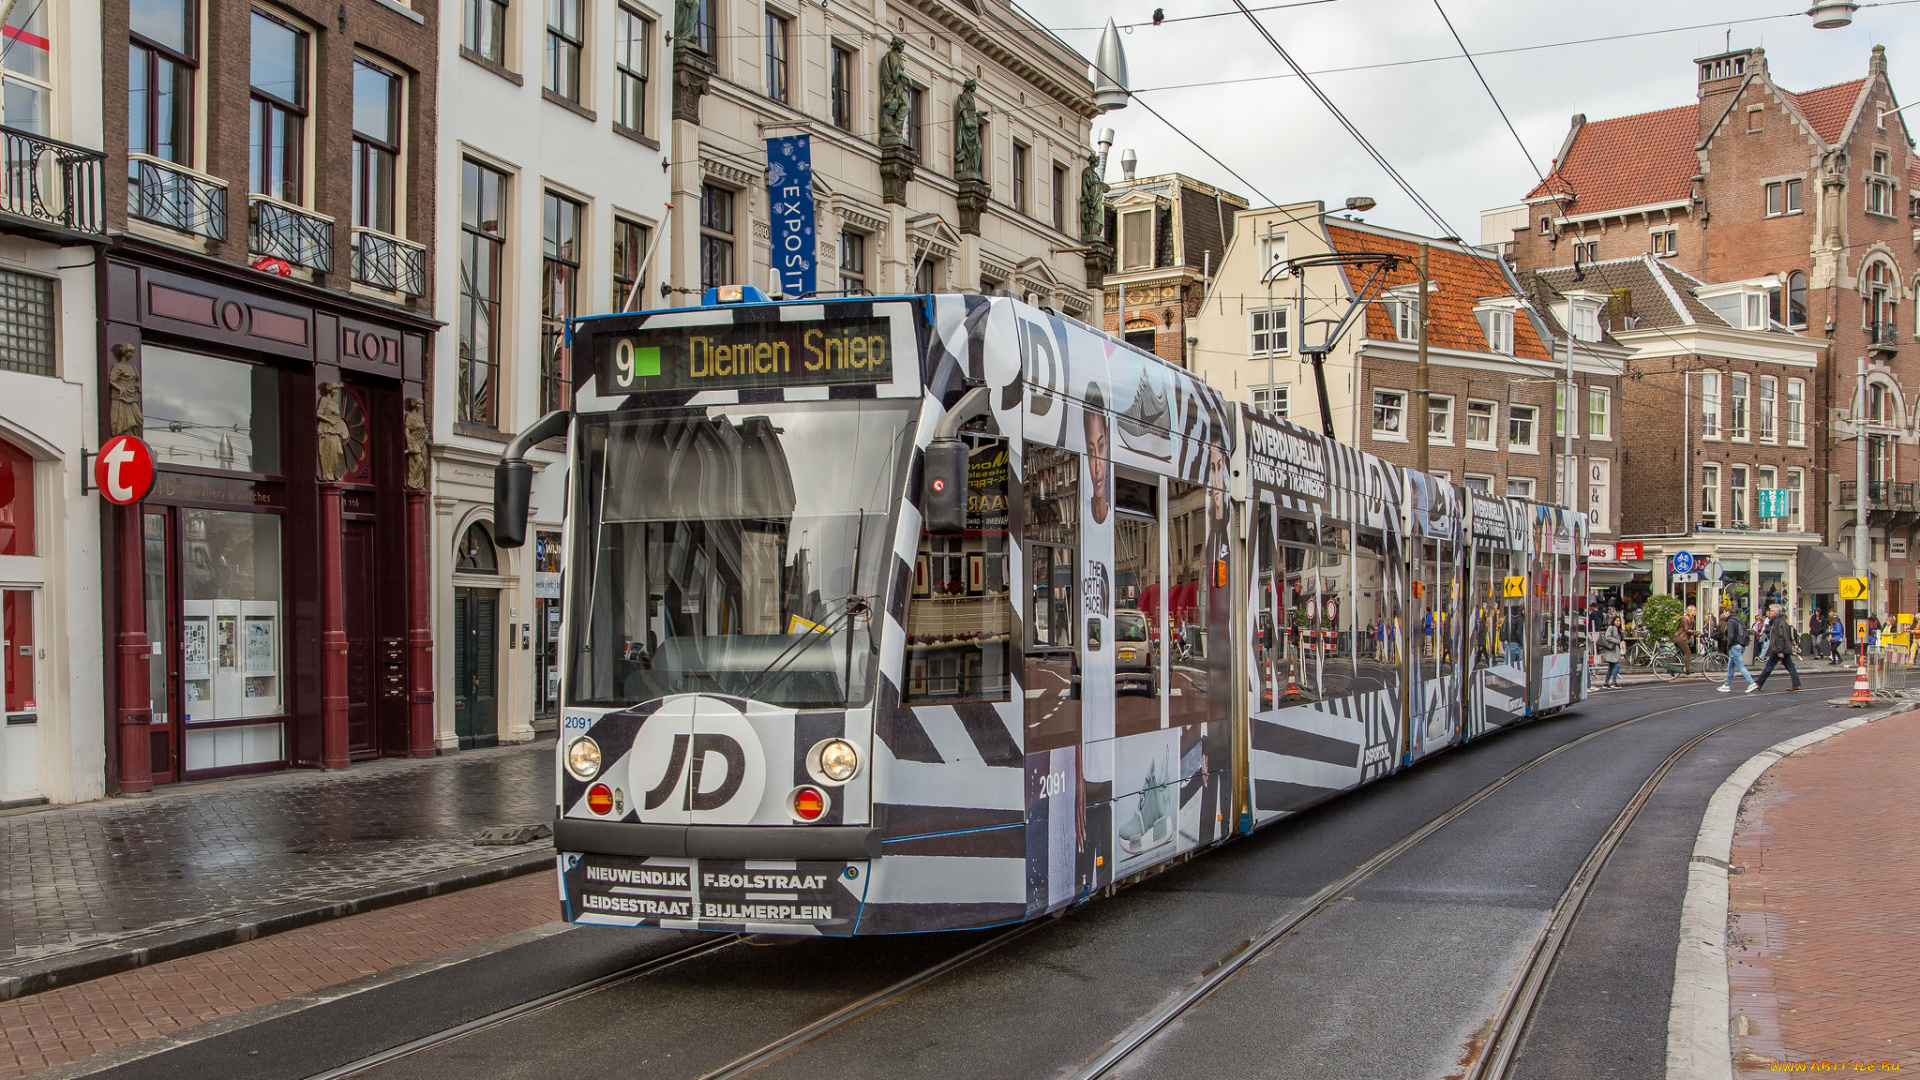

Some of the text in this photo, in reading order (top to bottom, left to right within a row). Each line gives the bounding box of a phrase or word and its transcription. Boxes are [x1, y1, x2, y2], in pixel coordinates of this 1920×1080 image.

[615, 328, 886, 387] 9 Diemen Sniep
[1252, 420, 1325, 473] OVERDUIDELIJK
[103, 438, 135, 502] t
[1253, 453, 1325, 499] KING OF TRAINERS
[1085, 596, 1101, 615] FACE
[564, 716, 593, 730] 2091
[644, 733, 746, 811] JD
[1039, 770, 1066, 799] 2091
[586, 866, 688, 887] NIEUWENDIJK
[703, 873, 827, 889] F.BOLSTRAAT
[582, 894, 690, 916] LEIDSESTRAAT
[705, 903, 832, 920] BIJLMERPLEIN
